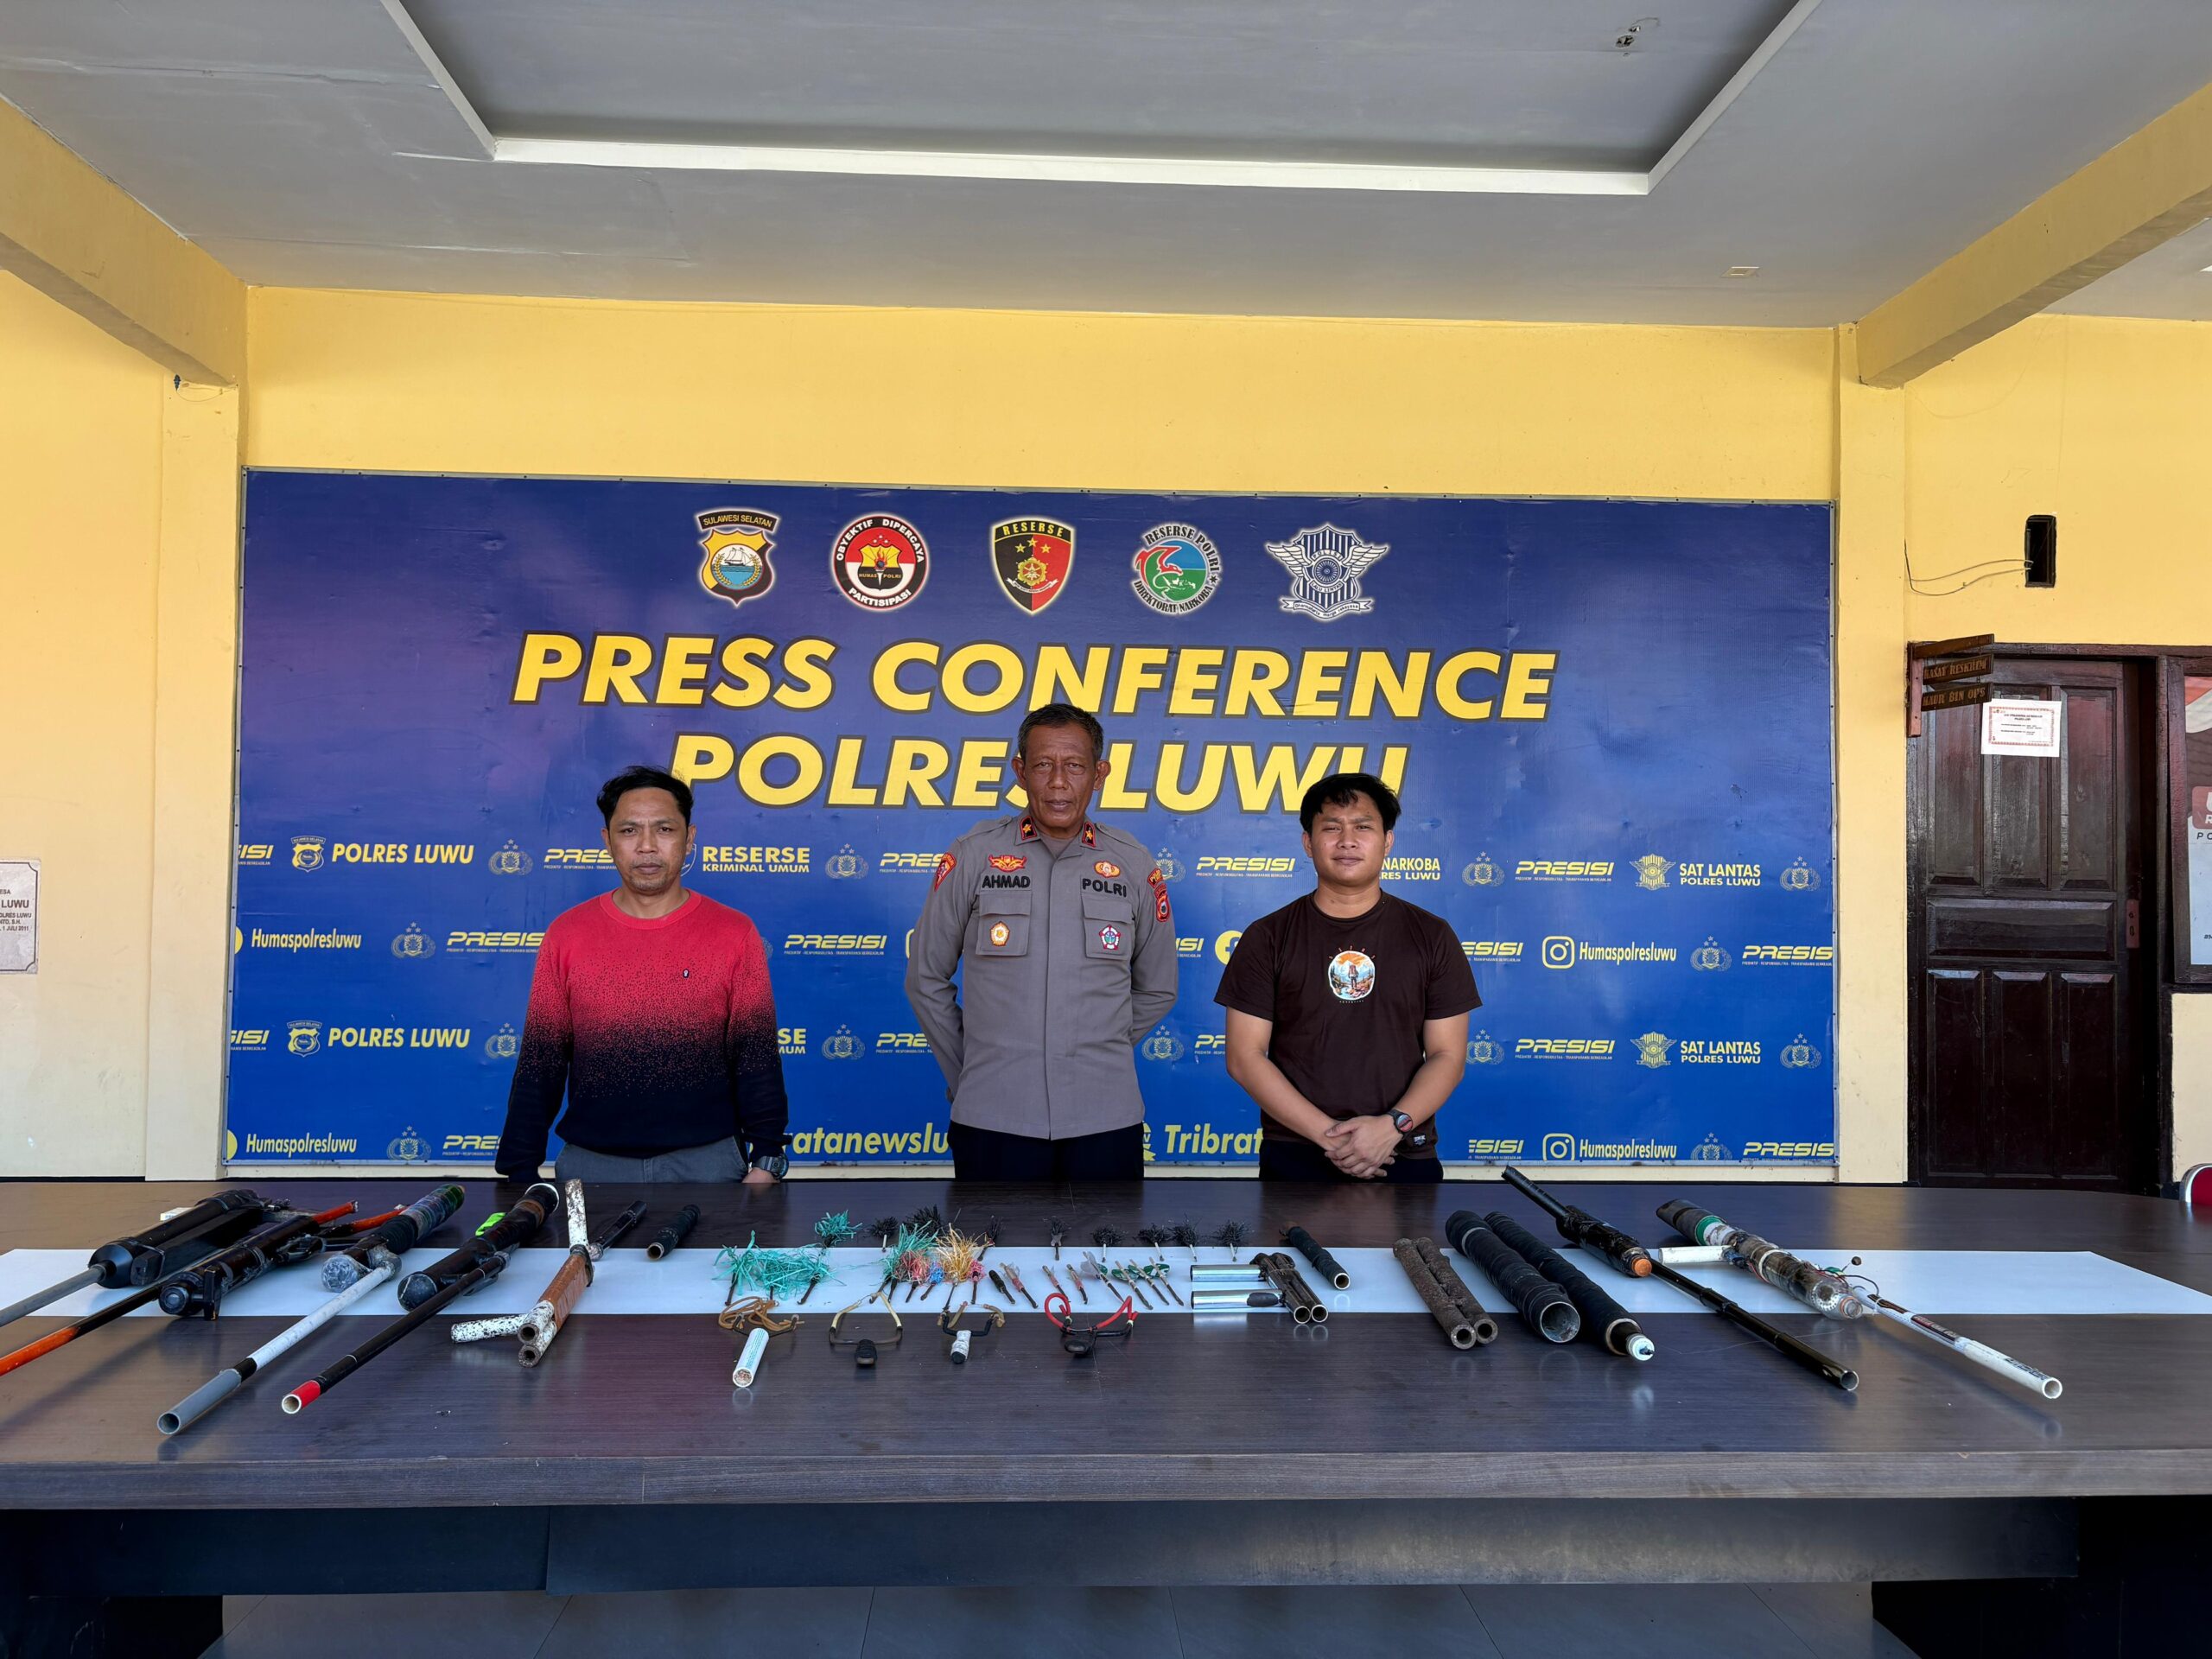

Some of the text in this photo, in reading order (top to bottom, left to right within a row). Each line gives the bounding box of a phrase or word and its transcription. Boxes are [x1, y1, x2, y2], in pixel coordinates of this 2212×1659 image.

[703, 514, 772, 528] SULAWESI SELATAN
[1002, 522, 1065, 537] RESERSE
[836, 518, 925, 563] OBYEKTIF DIPERCAYA
[1144, 525, 1220, 572] RESERSE POLRI
[849, 588, 912, 607] PARTISIPASI
[1134, 580, 1213, 613] DIREKTORAT NARKOBA
[513, 633, 1558, 720] PRESS CONFERENCE
[332, 842, 474, 863] POLRES LUWU
[702, 846, 810, 863] RESERSE
[768, 864, 810, 873] UMUM
[1196, 856, 1296, 872] PRESISI
[1382, 857, 1440, 871] NARKOBA
[1516, 861, 1615, 875] PRESISI
[1679, 863, 1761, 877] SAT LANTAS
[982, 875, 1031, 889] AHMAD
[1405, 872, 1440, 880] LUWU
[1680, 877, 1761, 887] POLRES LUWU
[1082, 878, 1127, 898] POLRI
[1, 899, 29, 908] LUWU
[251, 928, 362, 953] Humaspolresluwu
[785, 934, 887, 949] PRESISI
[1580, 941, 1676, 965] Humaspolresluwu
[328, 1027, 470, 1048] POLRES LUWU
[1515, 1039, 1615, 1053] PRESISI
[1680, 1040, 1761, 1055] SAT LANTAS
[1681, 1054, 1761, 1064] POLRES LUWU
[246, 1133, 358, 1154] Humaspolresluwu
[1580, 1138, 1677, 1159] Humaspolresluwu
